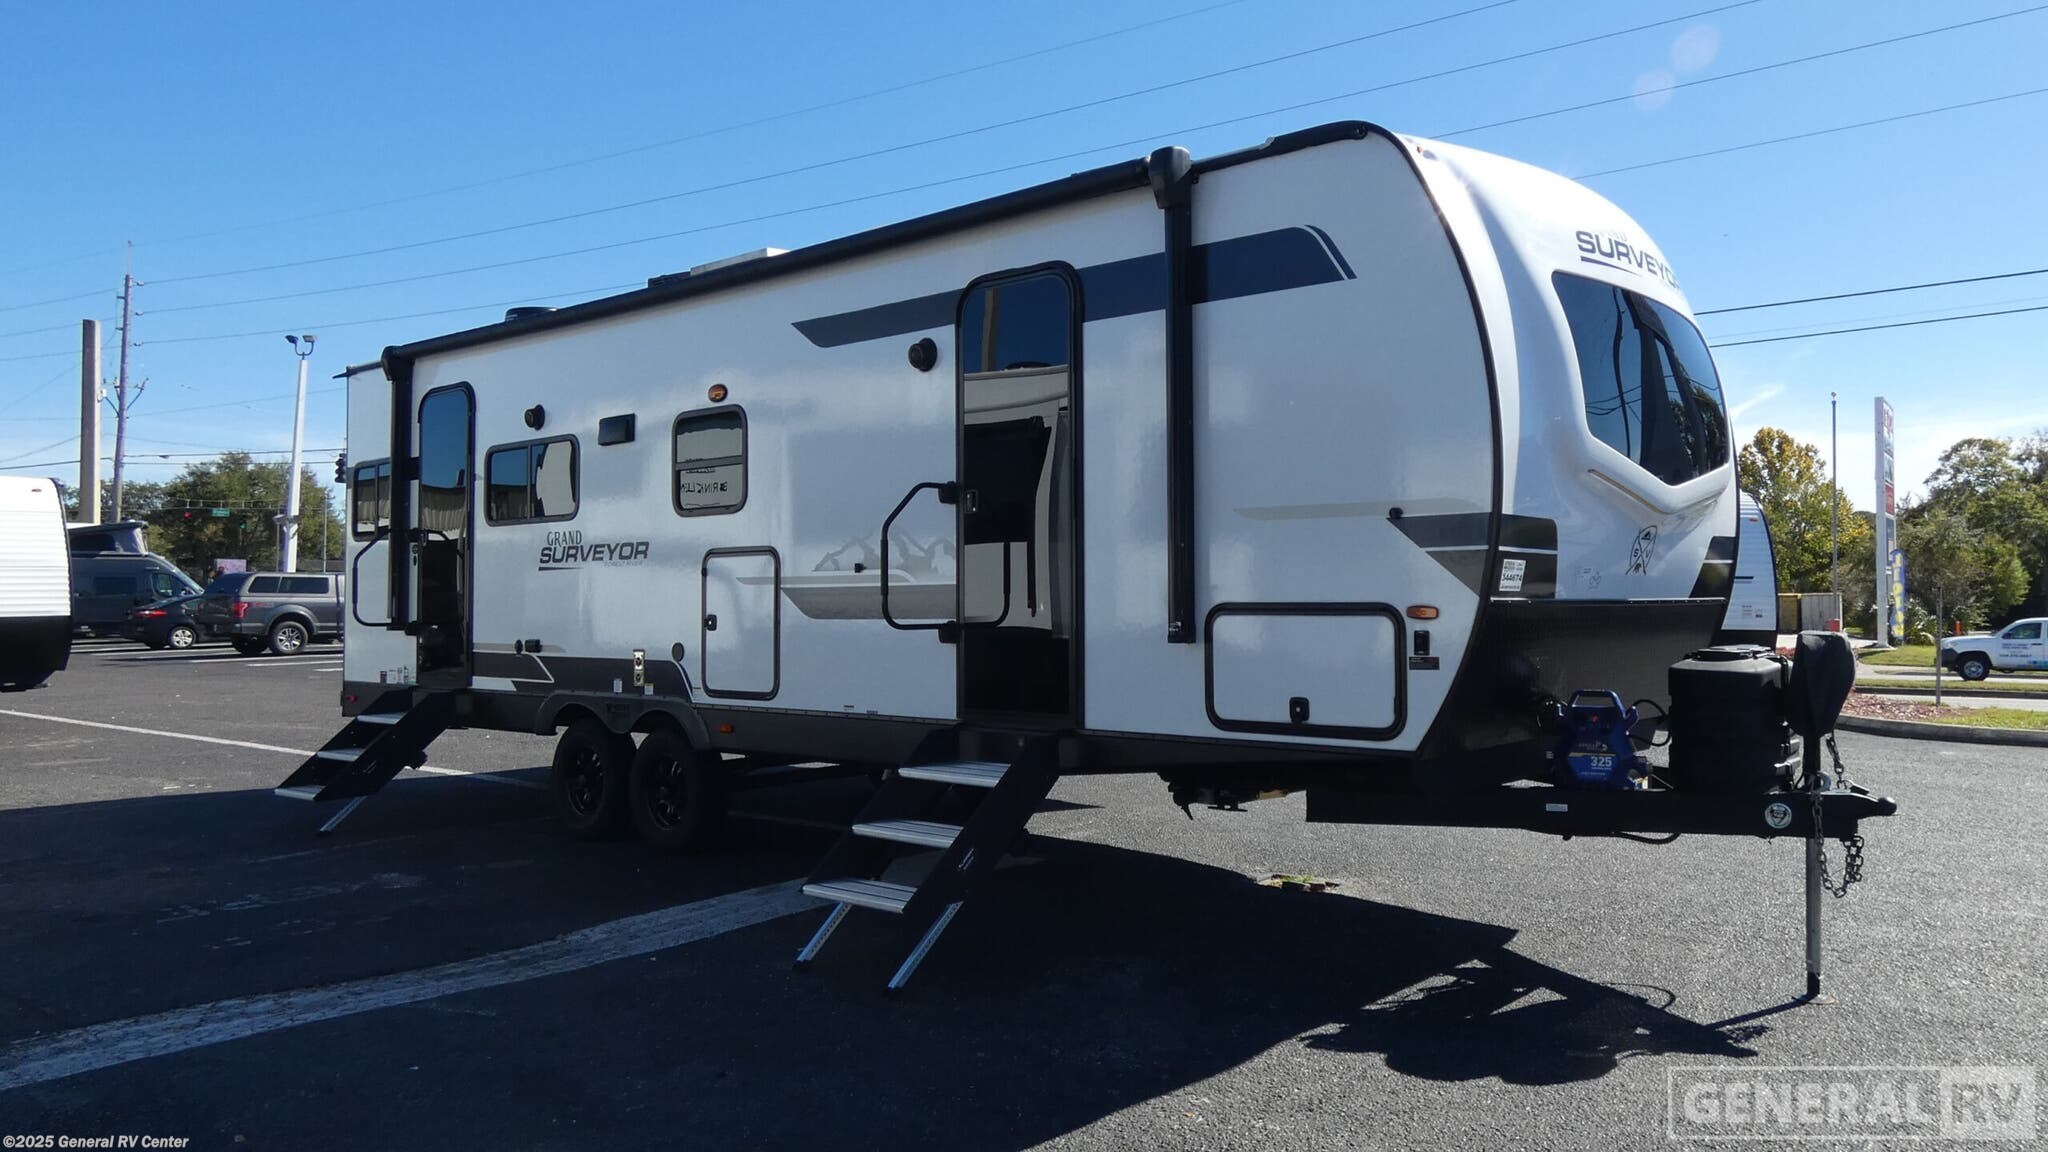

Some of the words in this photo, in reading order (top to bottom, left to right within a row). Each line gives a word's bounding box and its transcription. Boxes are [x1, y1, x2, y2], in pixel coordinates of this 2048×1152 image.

[1576, 231, 1680, 288] SURVEYO
[547, 530, 582, 547] GRAND
[539, 541, 650, 564] SURVEYOR
[1591, 756, 1612, 767] 325
